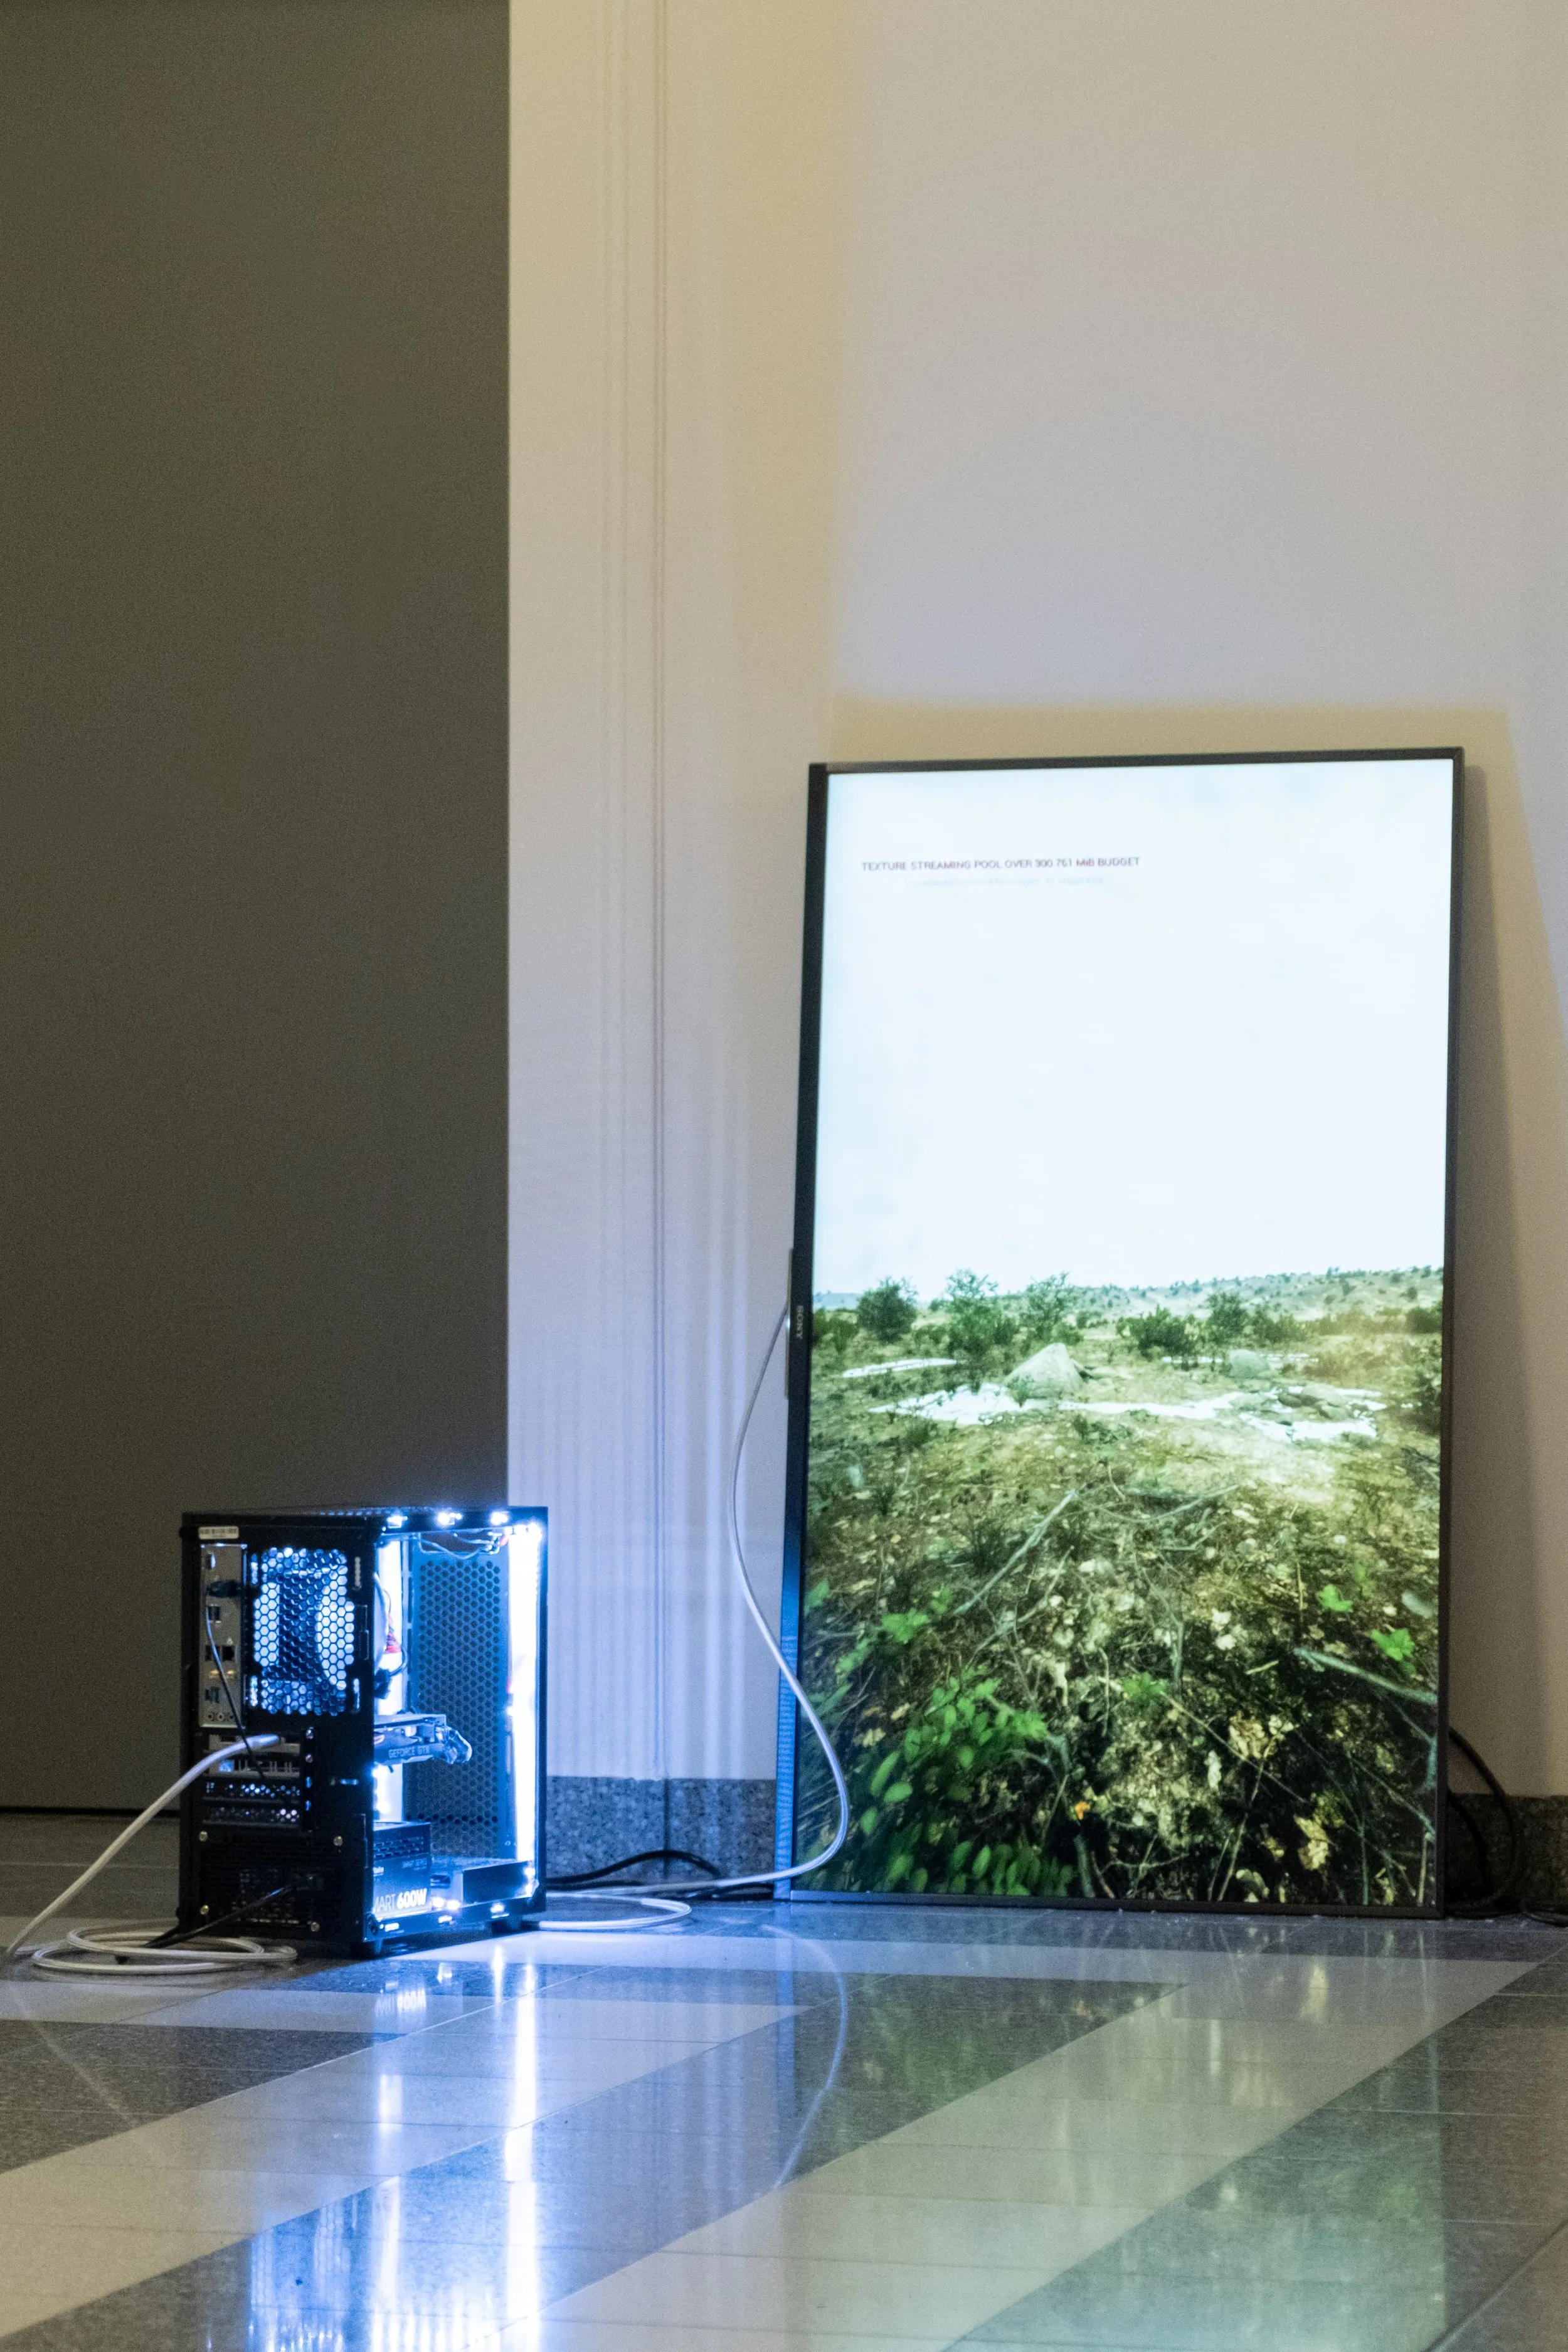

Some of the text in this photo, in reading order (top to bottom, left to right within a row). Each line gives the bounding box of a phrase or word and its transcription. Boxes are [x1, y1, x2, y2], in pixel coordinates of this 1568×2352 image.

[861, 861, 907, 872] TEXTURE
[911, 860, 972, 871] STREAMING
[973, 859, 1002, 869] POOL
[1004, 859, 1033, 869] OVER
[1098, 856, 1140, 867] BUDGET
[396, 1887, 428, 1909] 600W
